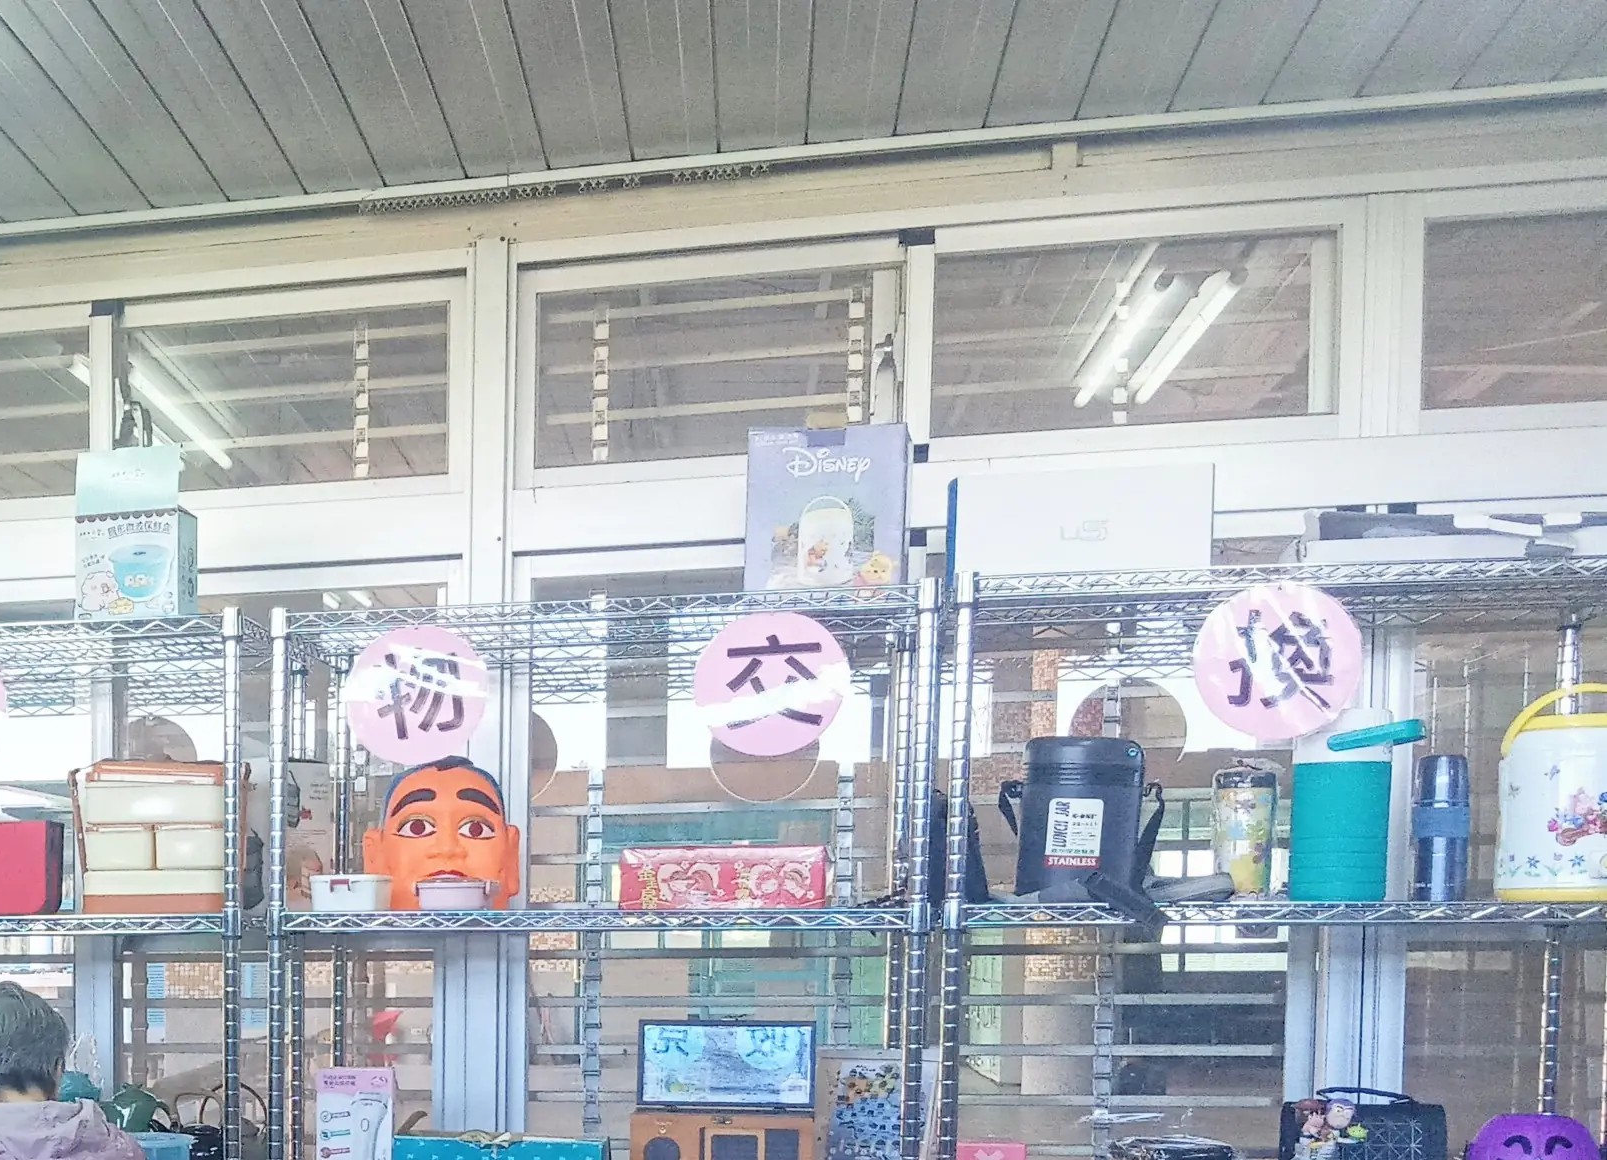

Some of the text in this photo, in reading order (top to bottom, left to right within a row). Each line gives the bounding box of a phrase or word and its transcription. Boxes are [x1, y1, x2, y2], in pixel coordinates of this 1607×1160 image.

[376, 651, 465, 740] 物
[725, 633, 823, 729] 交
[1052, 801, 1071, 848] LUNCH JAR
[1047, 856, 1097, 867] STAINLESS
